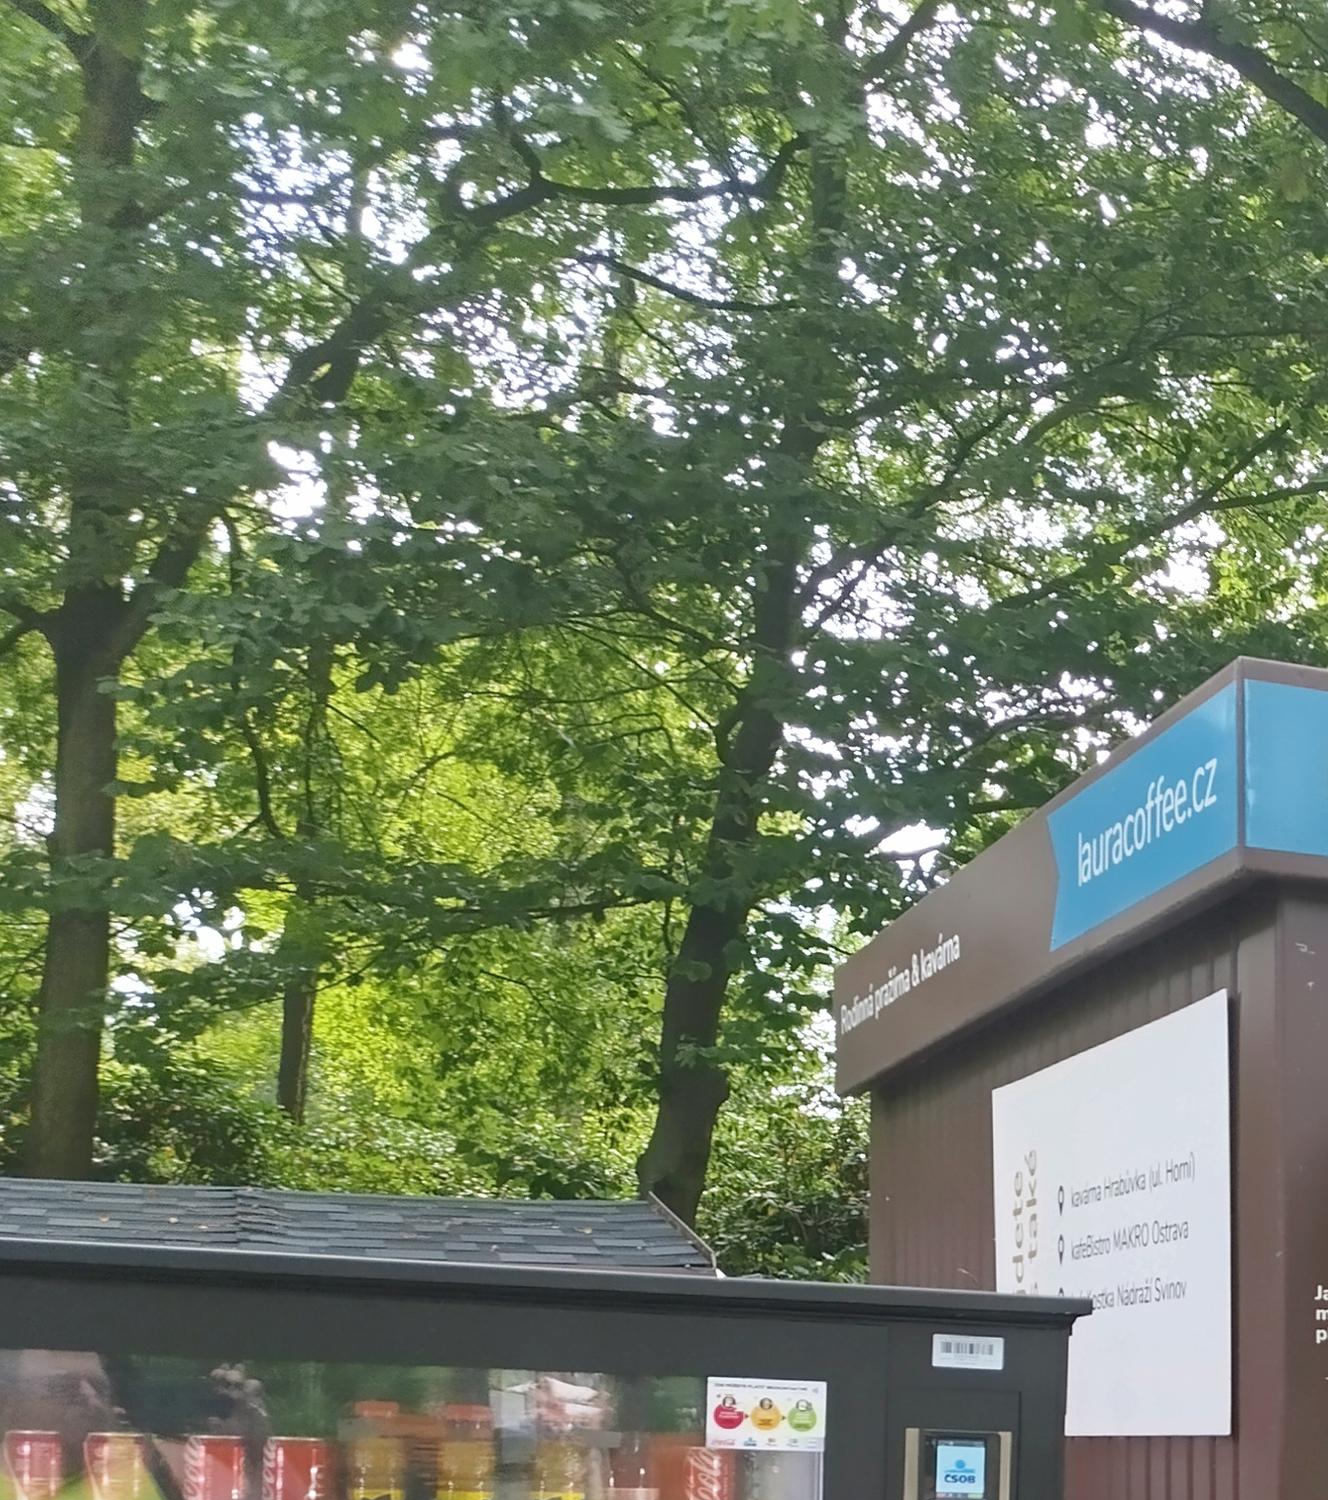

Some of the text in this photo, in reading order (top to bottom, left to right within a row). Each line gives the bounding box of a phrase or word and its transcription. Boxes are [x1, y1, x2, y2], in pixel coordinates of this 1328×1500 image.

[1075, 756, 1219, 887] lauracoffee.cz
[1152, 1219, 1189, 1246] Ostrava
[943, 1472, 977, 1485] ČSOB
